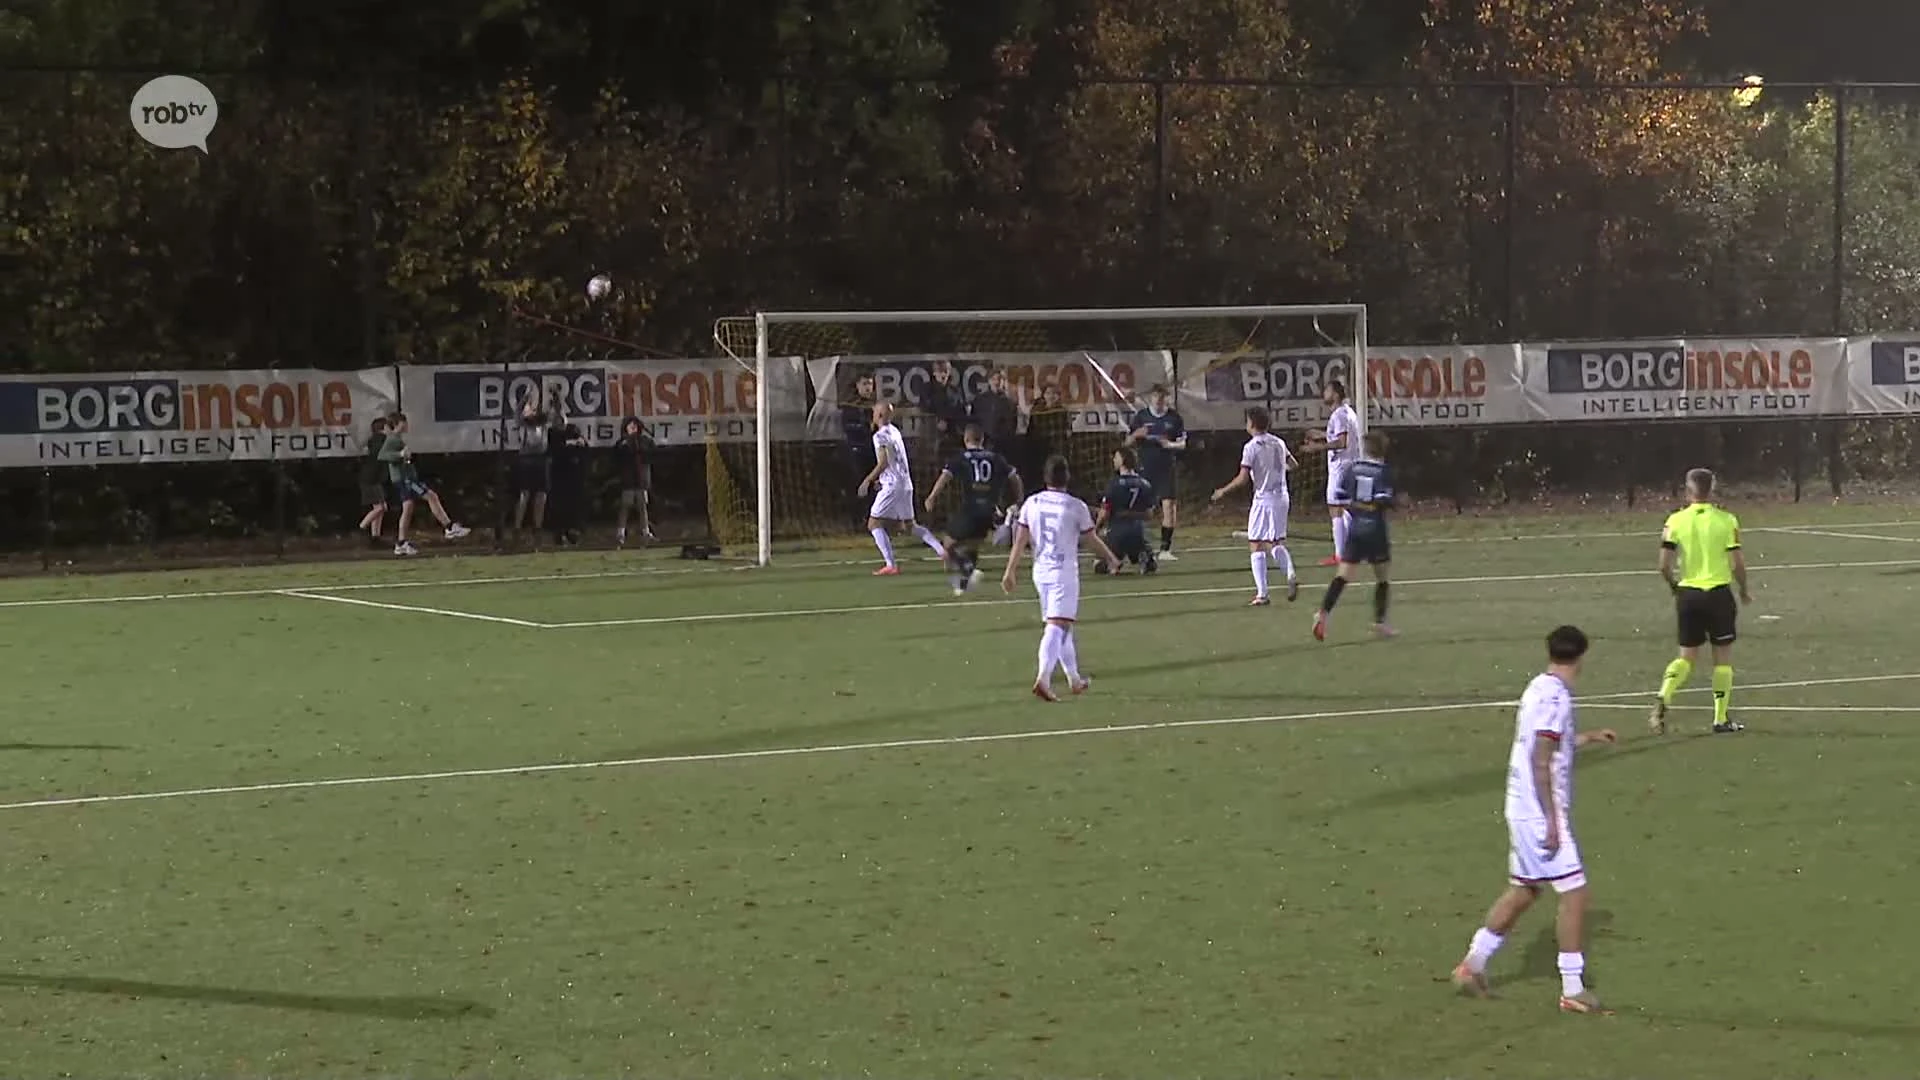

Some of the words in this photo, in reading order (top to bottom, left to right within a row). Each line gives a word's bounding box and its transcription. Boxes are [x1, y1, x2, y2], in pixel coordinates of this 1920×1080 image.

[1420, 403, 1485, 419] FOOT
[1583, 395, 1738, 414] INTELLIGENT
[1751, 394, 1811, 410] FOOT
[39, 435, 255, 459] INTELLIGENT
[271, 433, 351, 453] FOOT
[970, 459, 992, 482] 10
[1129, 487, 1140, 509] 7
